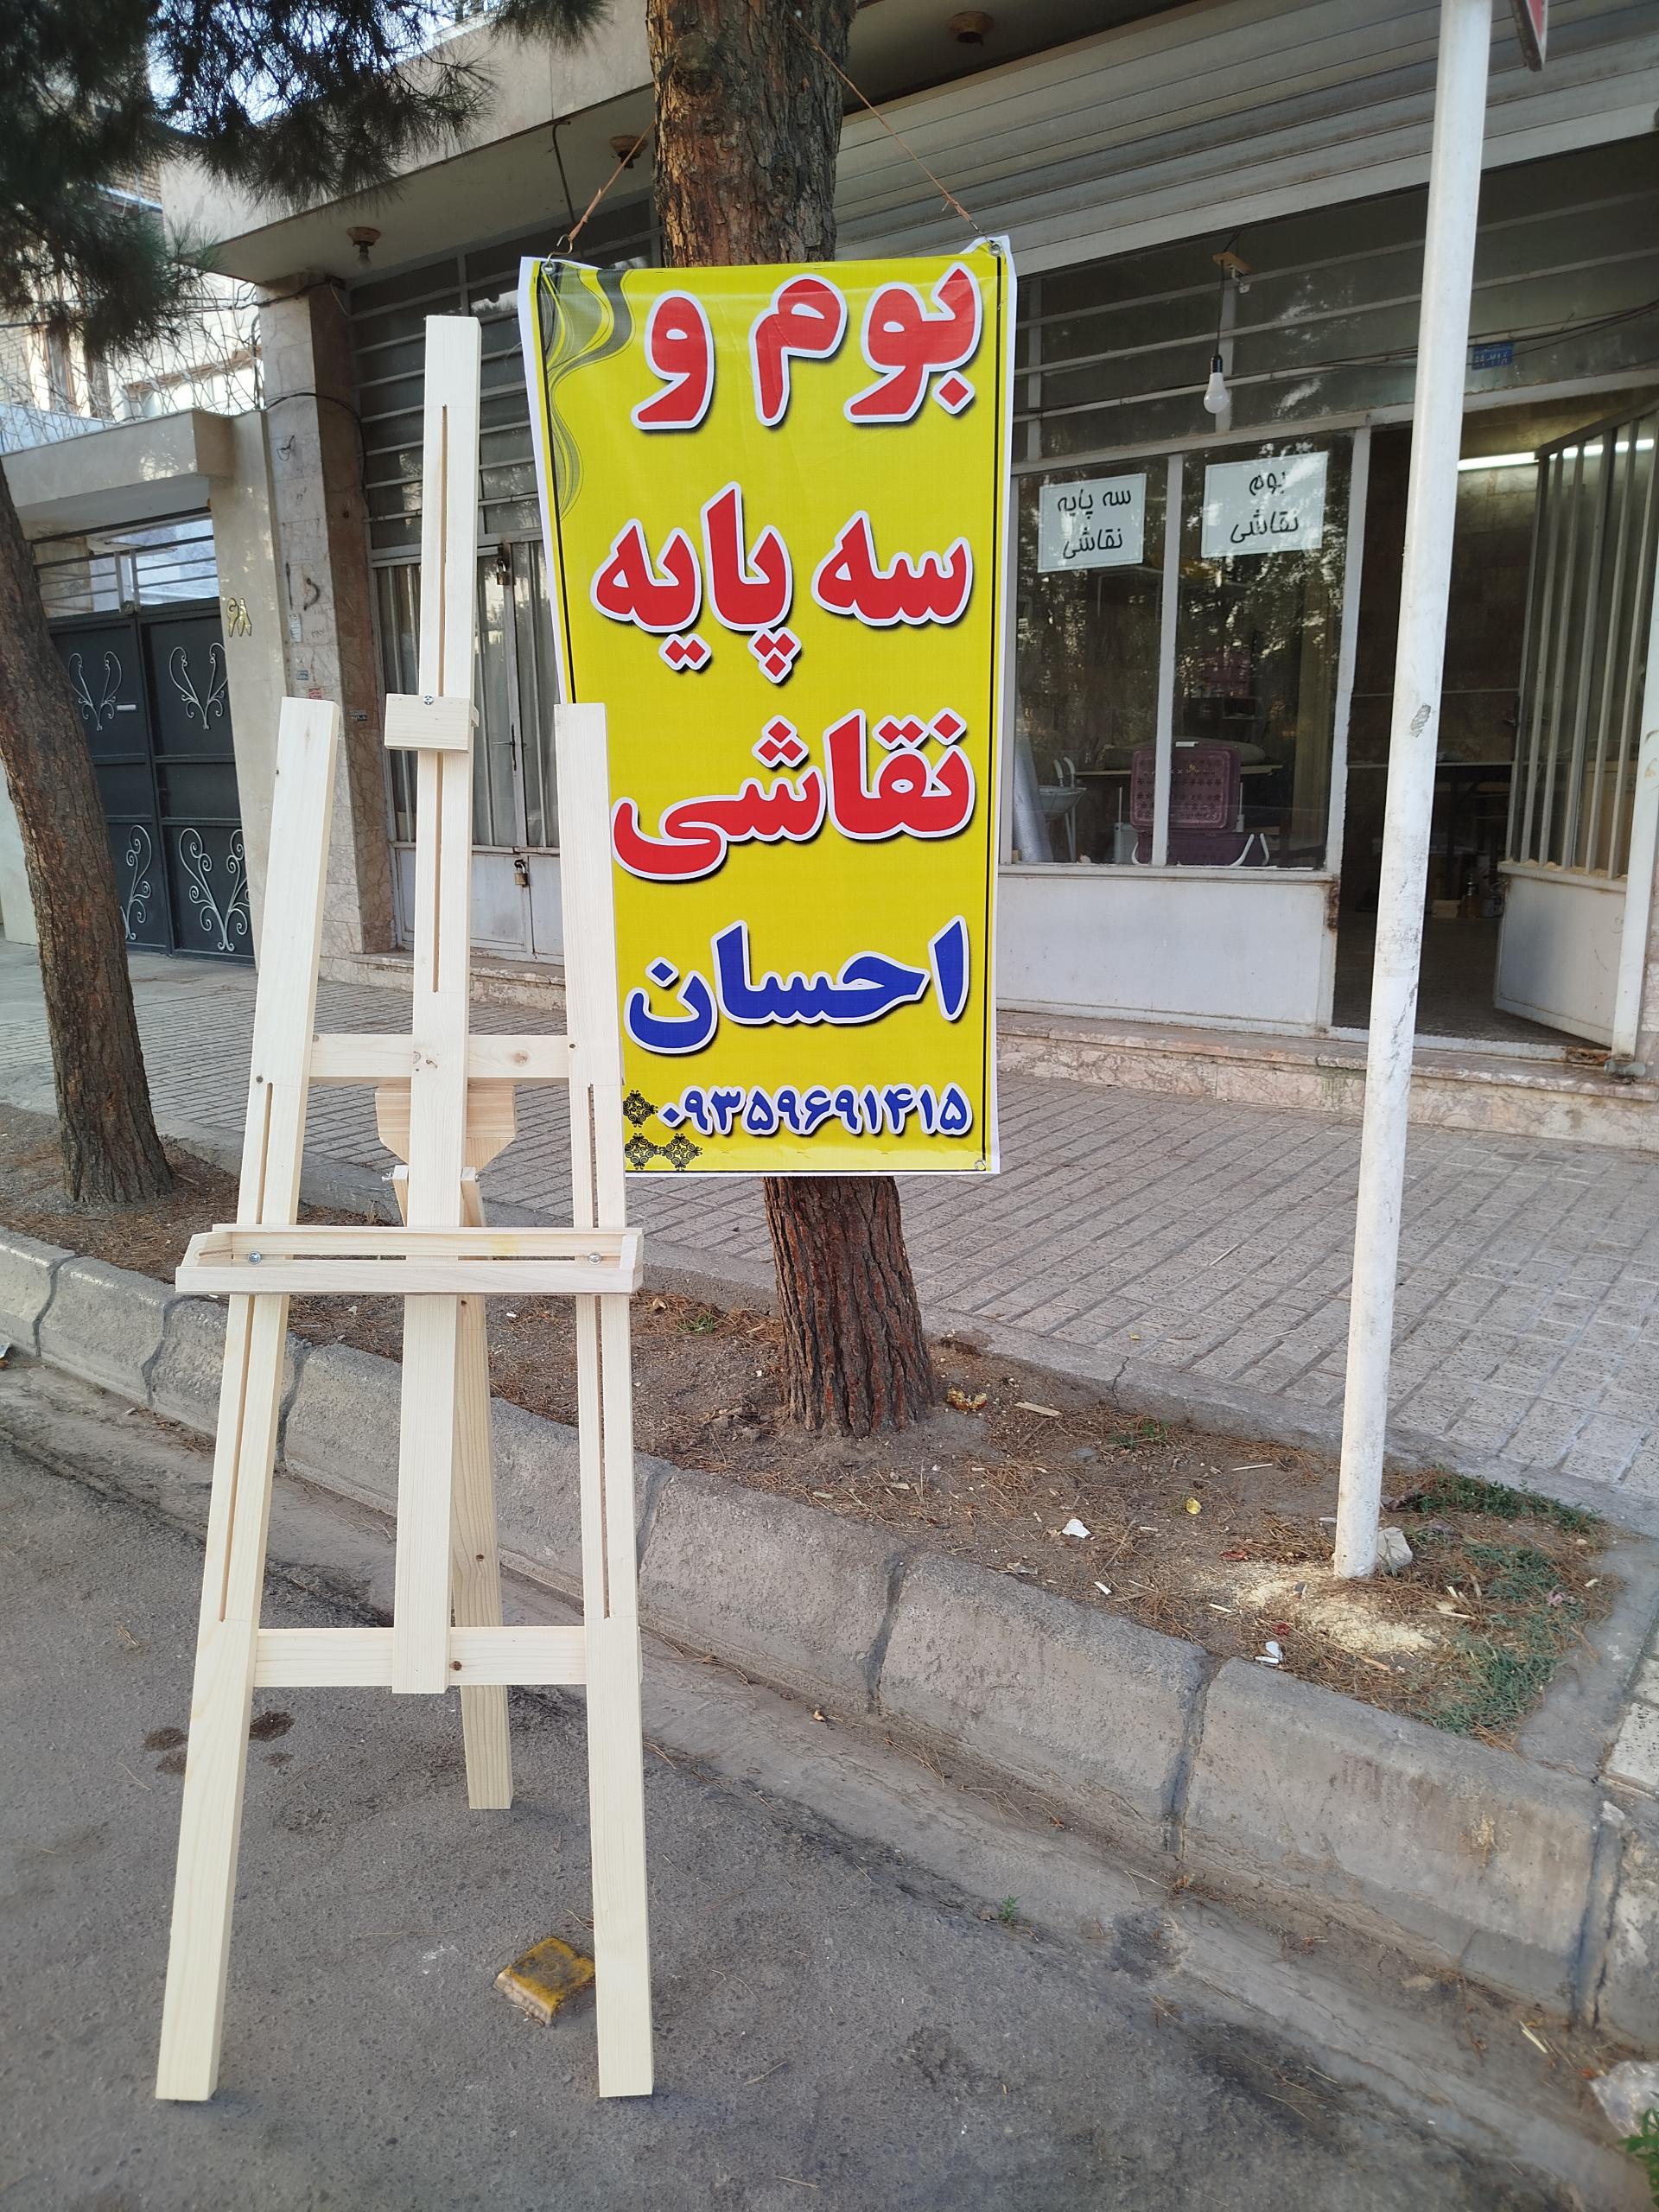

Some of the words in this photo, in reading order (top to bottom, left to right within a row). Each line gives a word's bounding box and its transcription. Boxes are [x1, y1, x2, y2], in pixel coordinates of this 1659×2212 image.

[634, 293, 712, 427] و
[752, 264, 979, 423] بوم
[1057, 488, 1094, 520] پایه
[1102, 489, 1132, 507] سه
[1249, 471, 1286, 496] بوم
[1063, 527, 1123, 560] نقاشی
[1230, 509, 1299, 543] نقاشی
[594, 486, 798, 680] پایه
[815, 514, 970, 624] سه
[612, 709, 973, 878] نقاشی
[626, 918, 969, 1052] احسان
[659, 1084, 972, 1135] ۰۹۳۵۹۶۹۱۴۱۵
